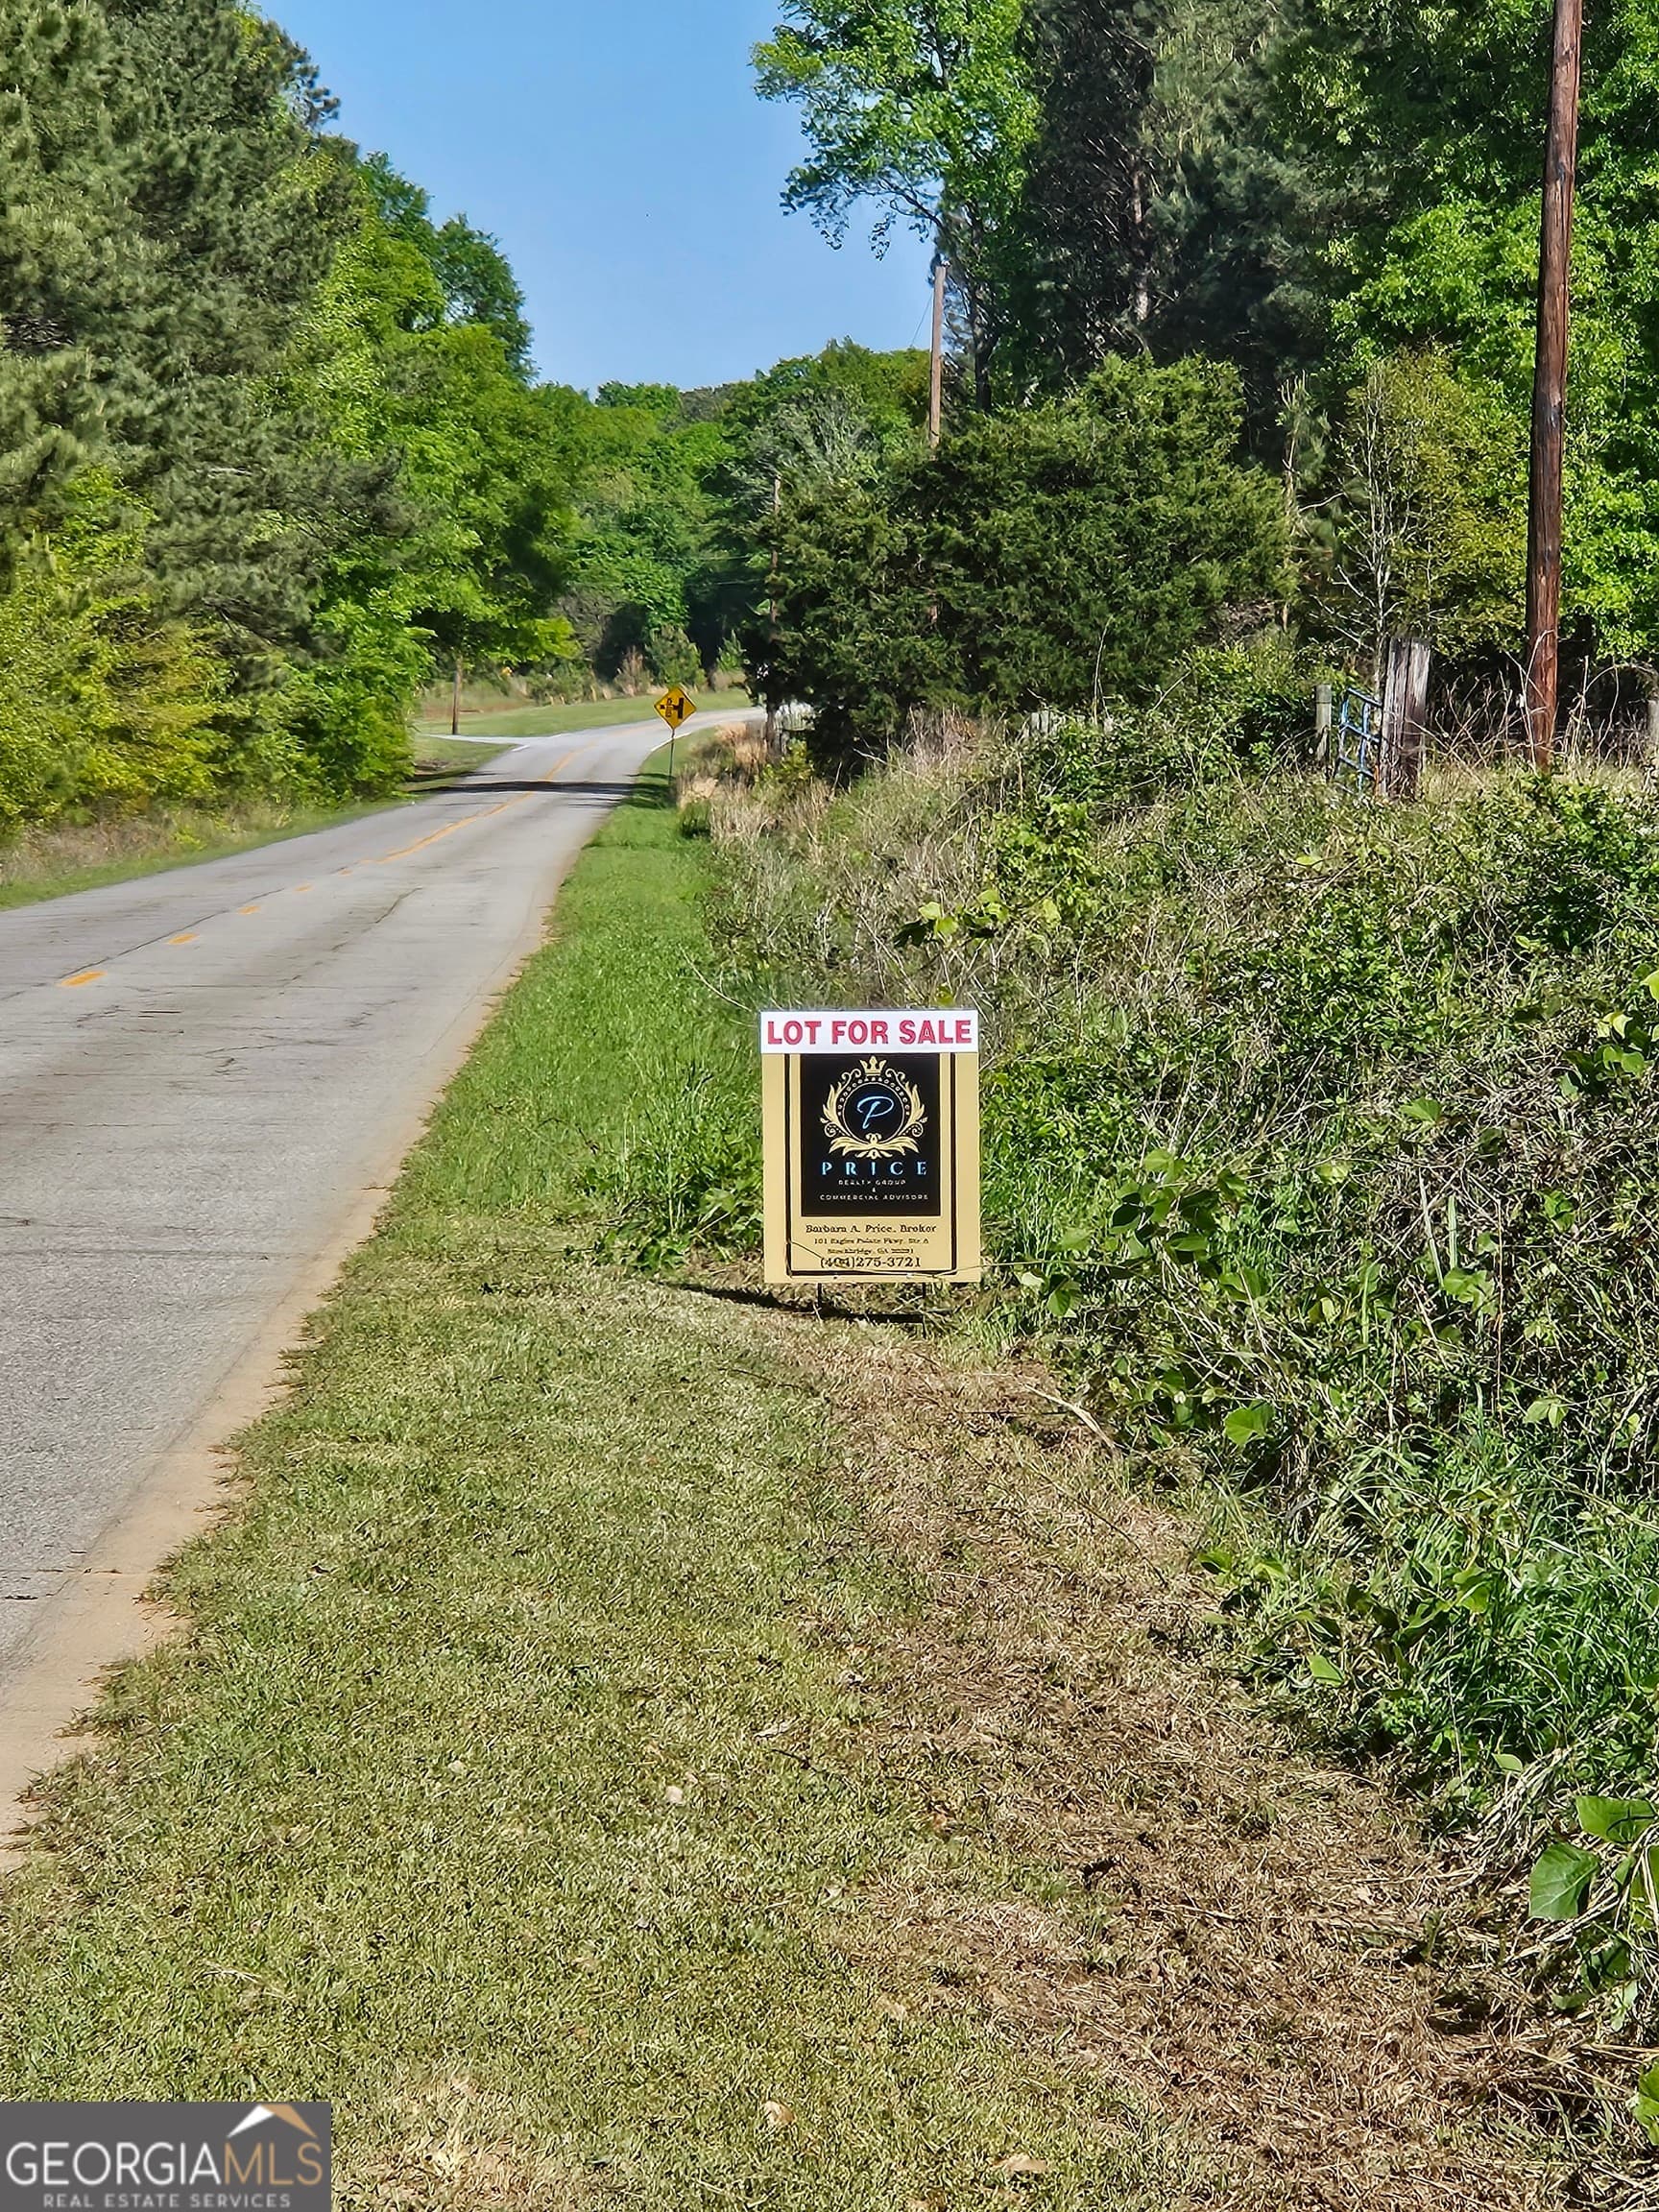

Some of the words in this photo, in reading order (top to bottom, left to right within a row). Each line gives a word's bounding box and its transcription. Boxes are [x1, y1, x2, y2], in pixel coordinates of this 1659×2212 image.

[767, 1021, 822, 1045] LOT
[831, 1021, 889, 1045] FOR
[899, 1020, 972, 1045] SALE
[856, 1095, 895, 1129] P
[822, 1161, 927, 1176] PRICE
[805, 1224, 847, 1233] Barbara
[900, 1224, 937, 1233] Broker
